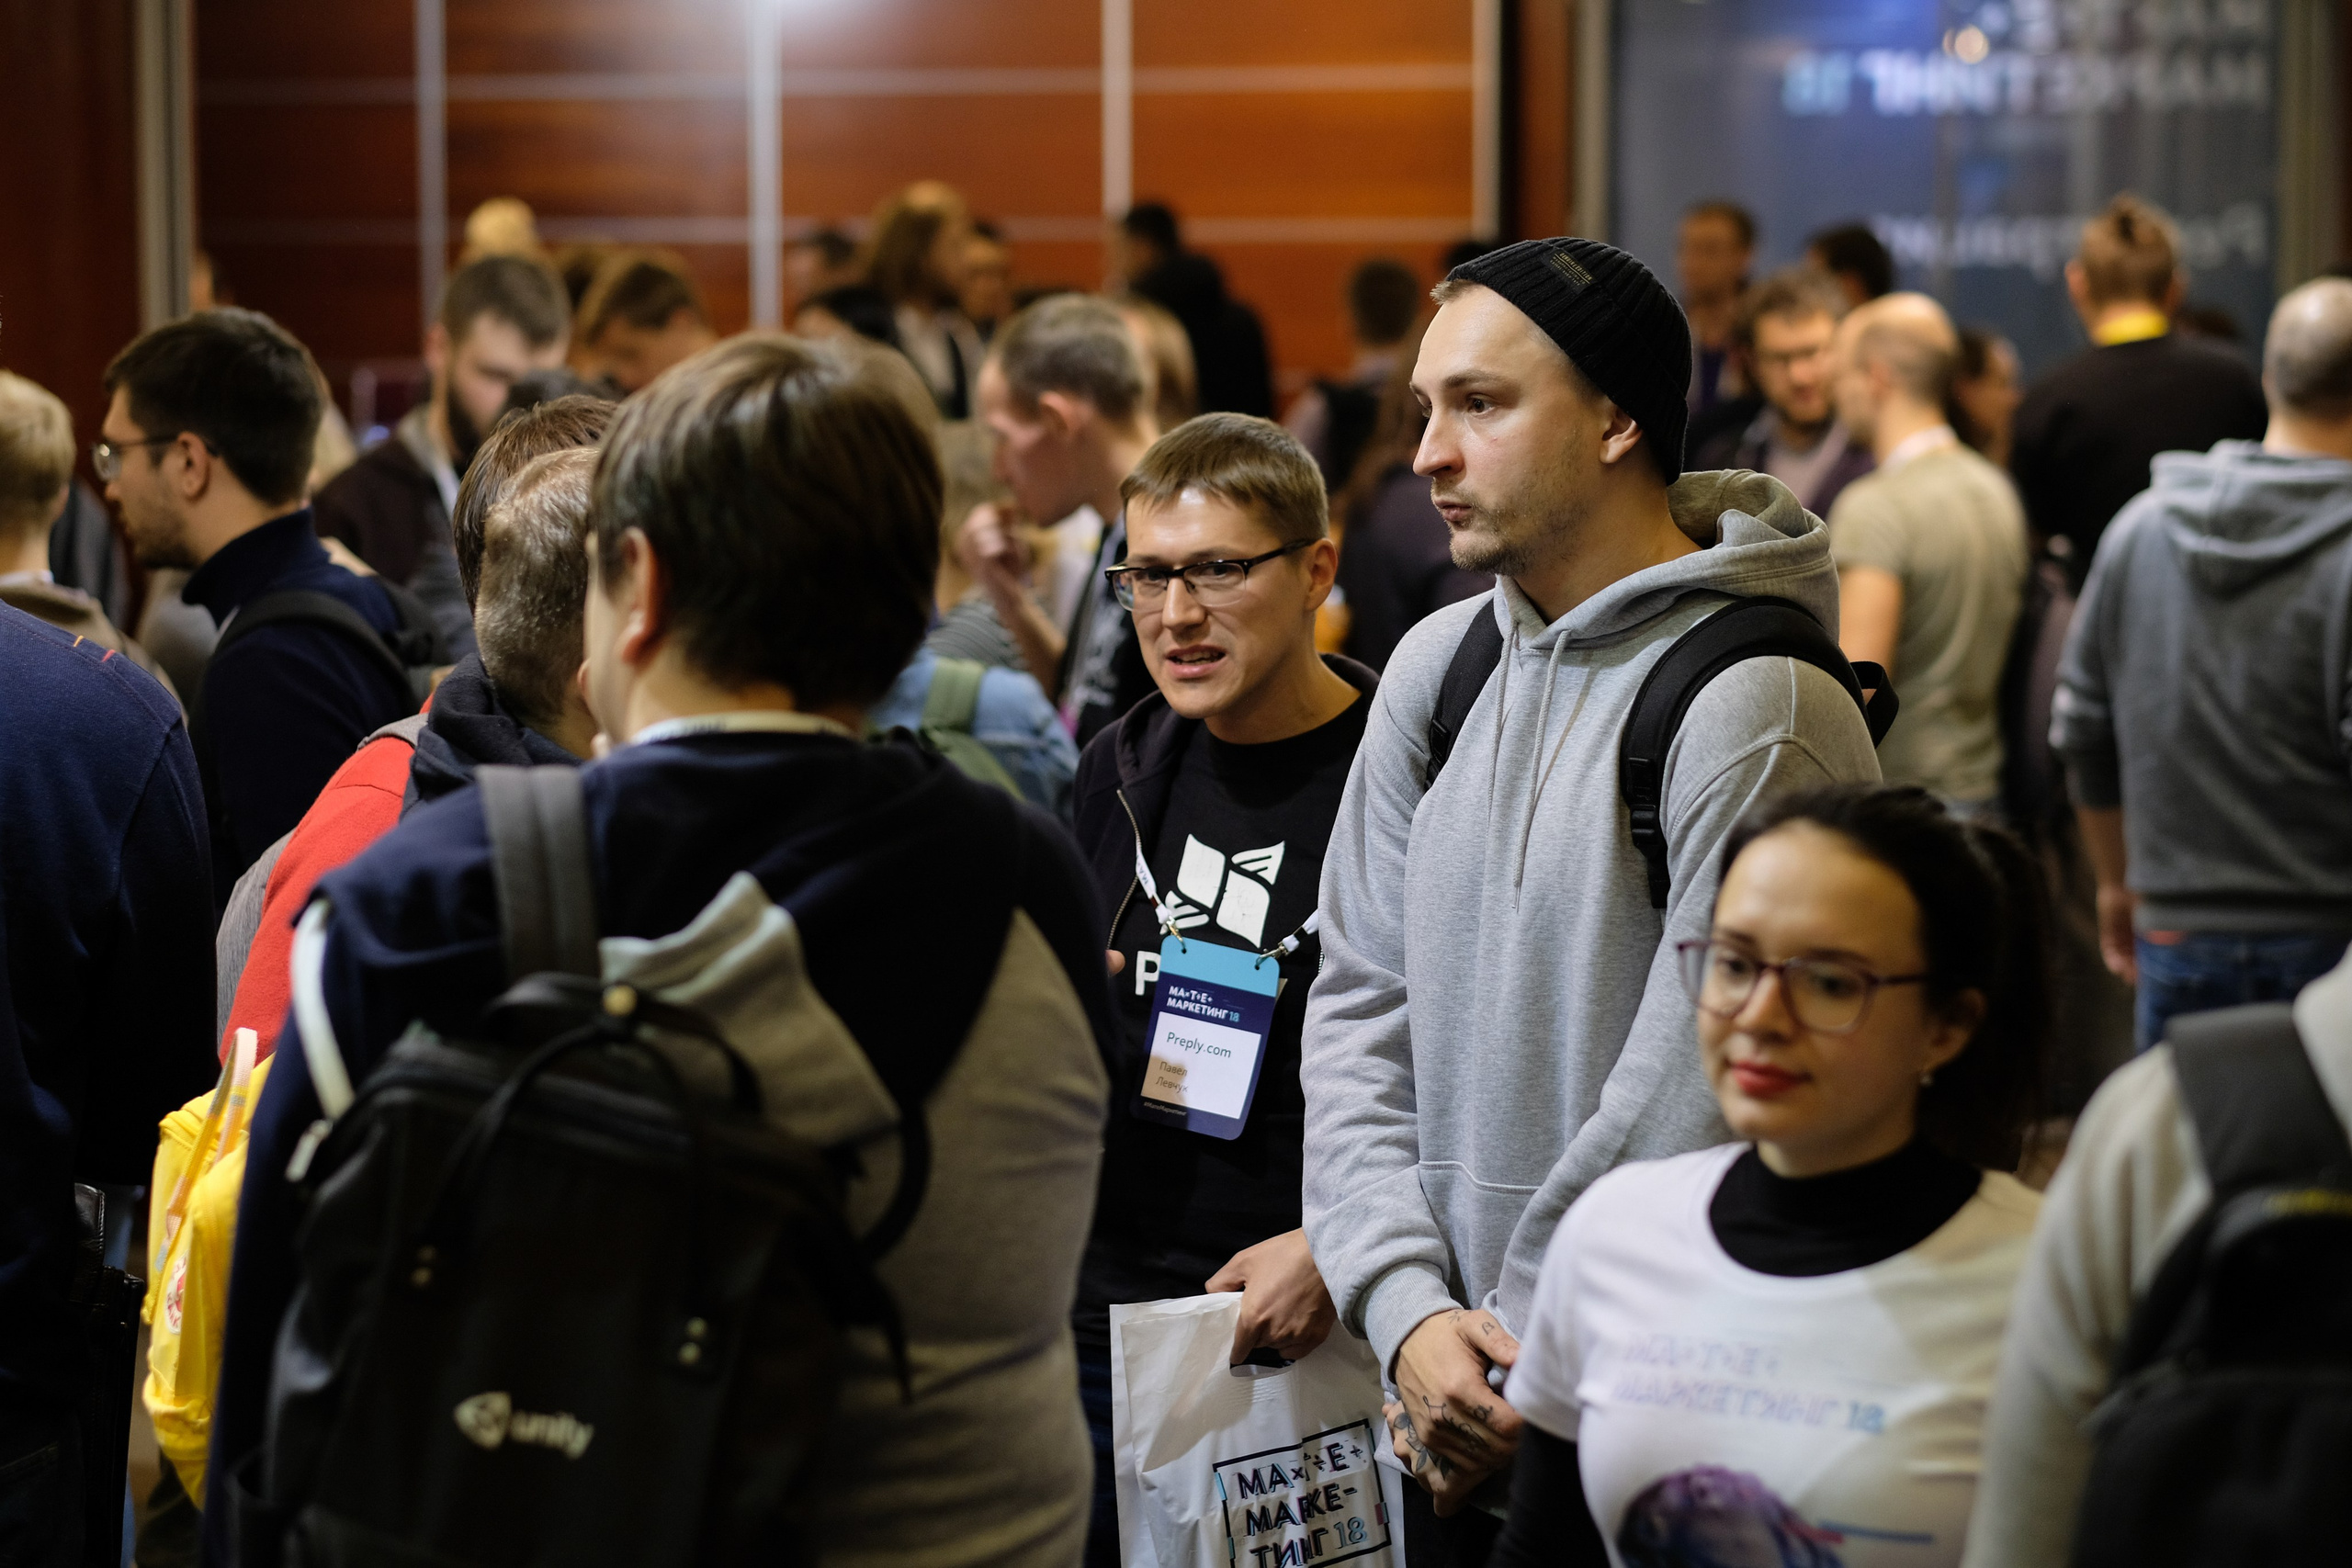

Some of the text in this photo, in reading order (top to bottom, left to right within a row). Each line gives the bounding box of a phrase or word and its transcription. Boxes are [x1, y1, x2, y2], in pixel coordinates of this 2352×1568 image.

[1166, 997, 1240, 1022] МАРКЕТИНГ 18
[1166, 1032, 1232, 1058] Preply.com
[1159, 1061, 1188, 1077] Павел
[1155, 1076, 1189, 1094] Левчук
[509, 1408, 595, 1461] unity
[1333, 1516, 1368, 1550] 18
